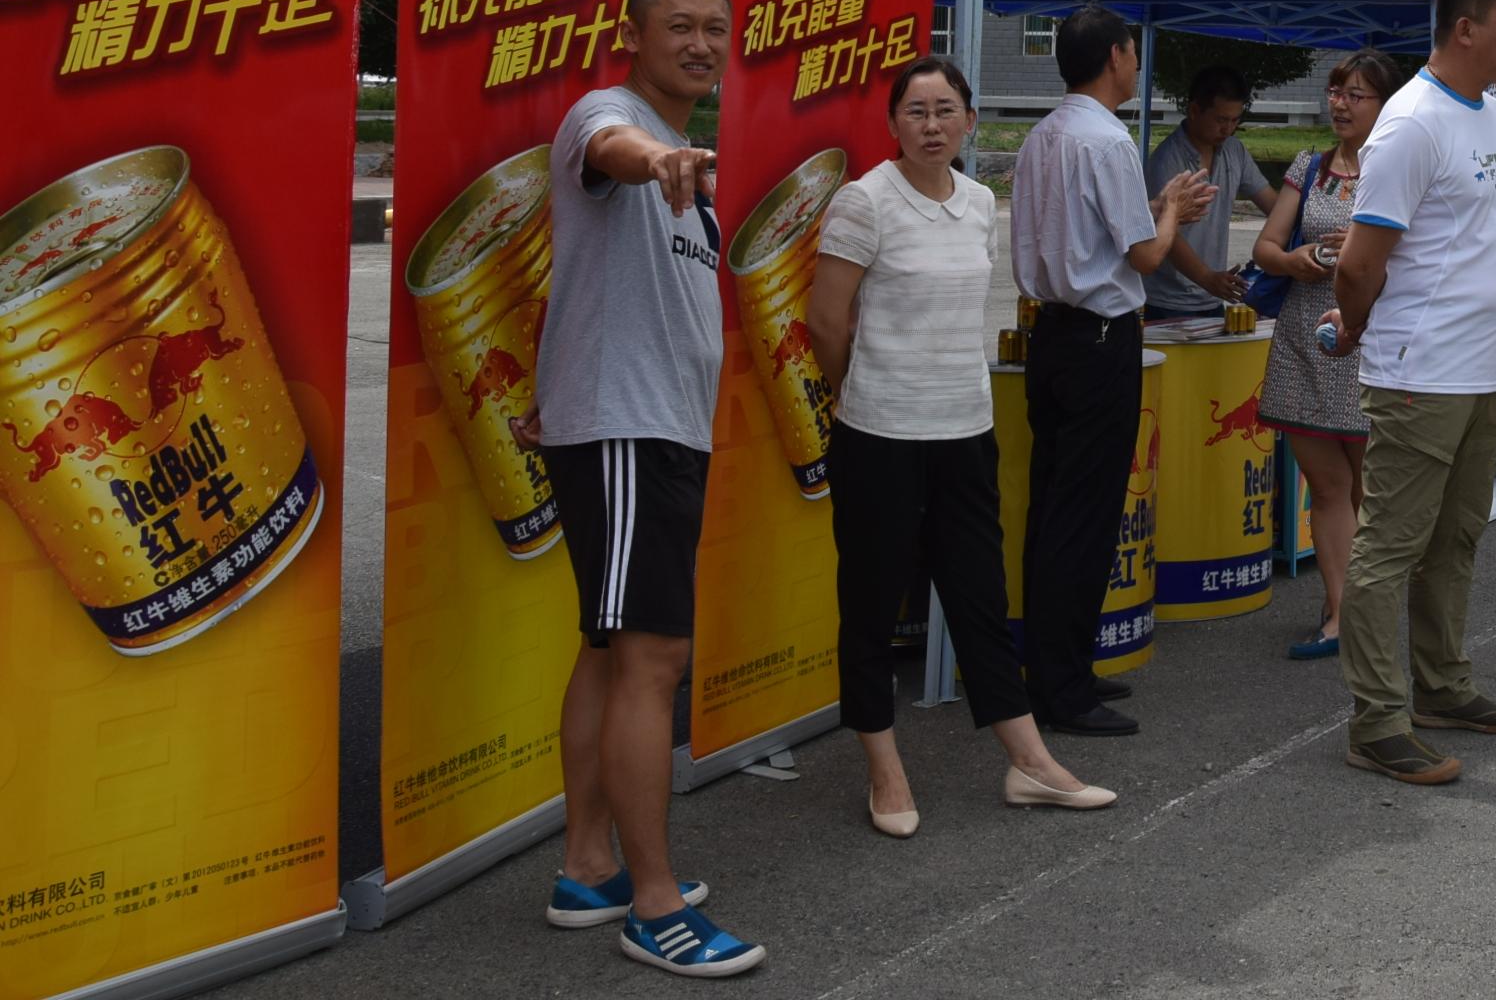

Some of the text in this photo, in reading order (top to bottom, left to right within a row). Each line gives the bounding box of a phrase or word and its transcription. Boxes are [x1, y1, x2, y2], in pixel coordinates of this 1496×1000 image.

[793, 16, 918, 103] 精力十足
[109, 413, 228, 527] RedBull
[123, 485, 306, 633] 红牛维生素功能饮料
[139, 471, 244, 570] 红牛
[514, 499, 559, 541] 红牛维
[10, 908, 52, 929] DRINK
